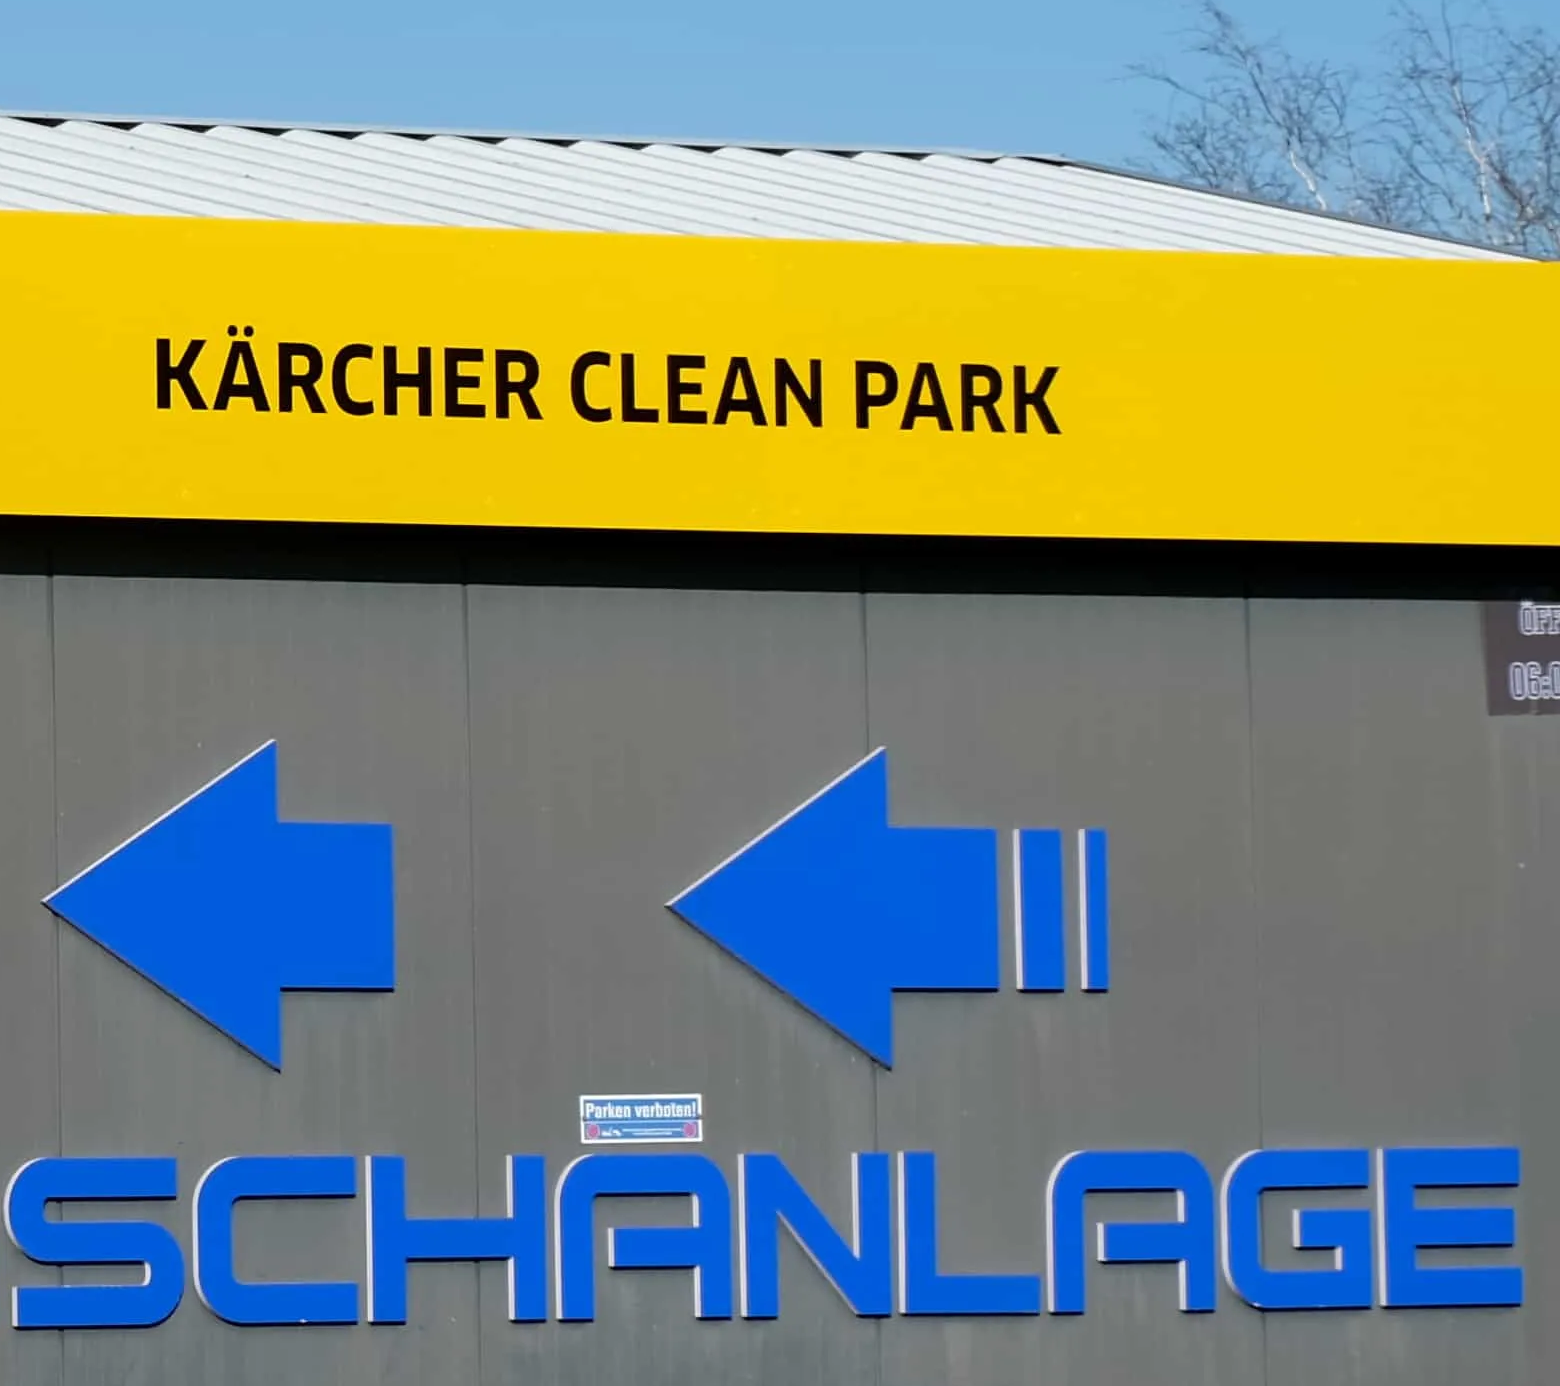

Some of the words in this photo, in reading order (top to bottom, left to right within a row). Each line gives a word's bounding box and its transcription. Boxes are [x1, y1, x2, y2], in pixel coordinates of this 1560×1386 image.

[156, 324, 543, 420] KÄRCHER
[570, 350, 823, 428] CLEAN
[855, 360, 1062, 435] PARK
[1510, 661, 1560, 701] 06:0
[585, 1102, 631, 1119] Parken
[634, 1101, 697, 1118] verboten!
